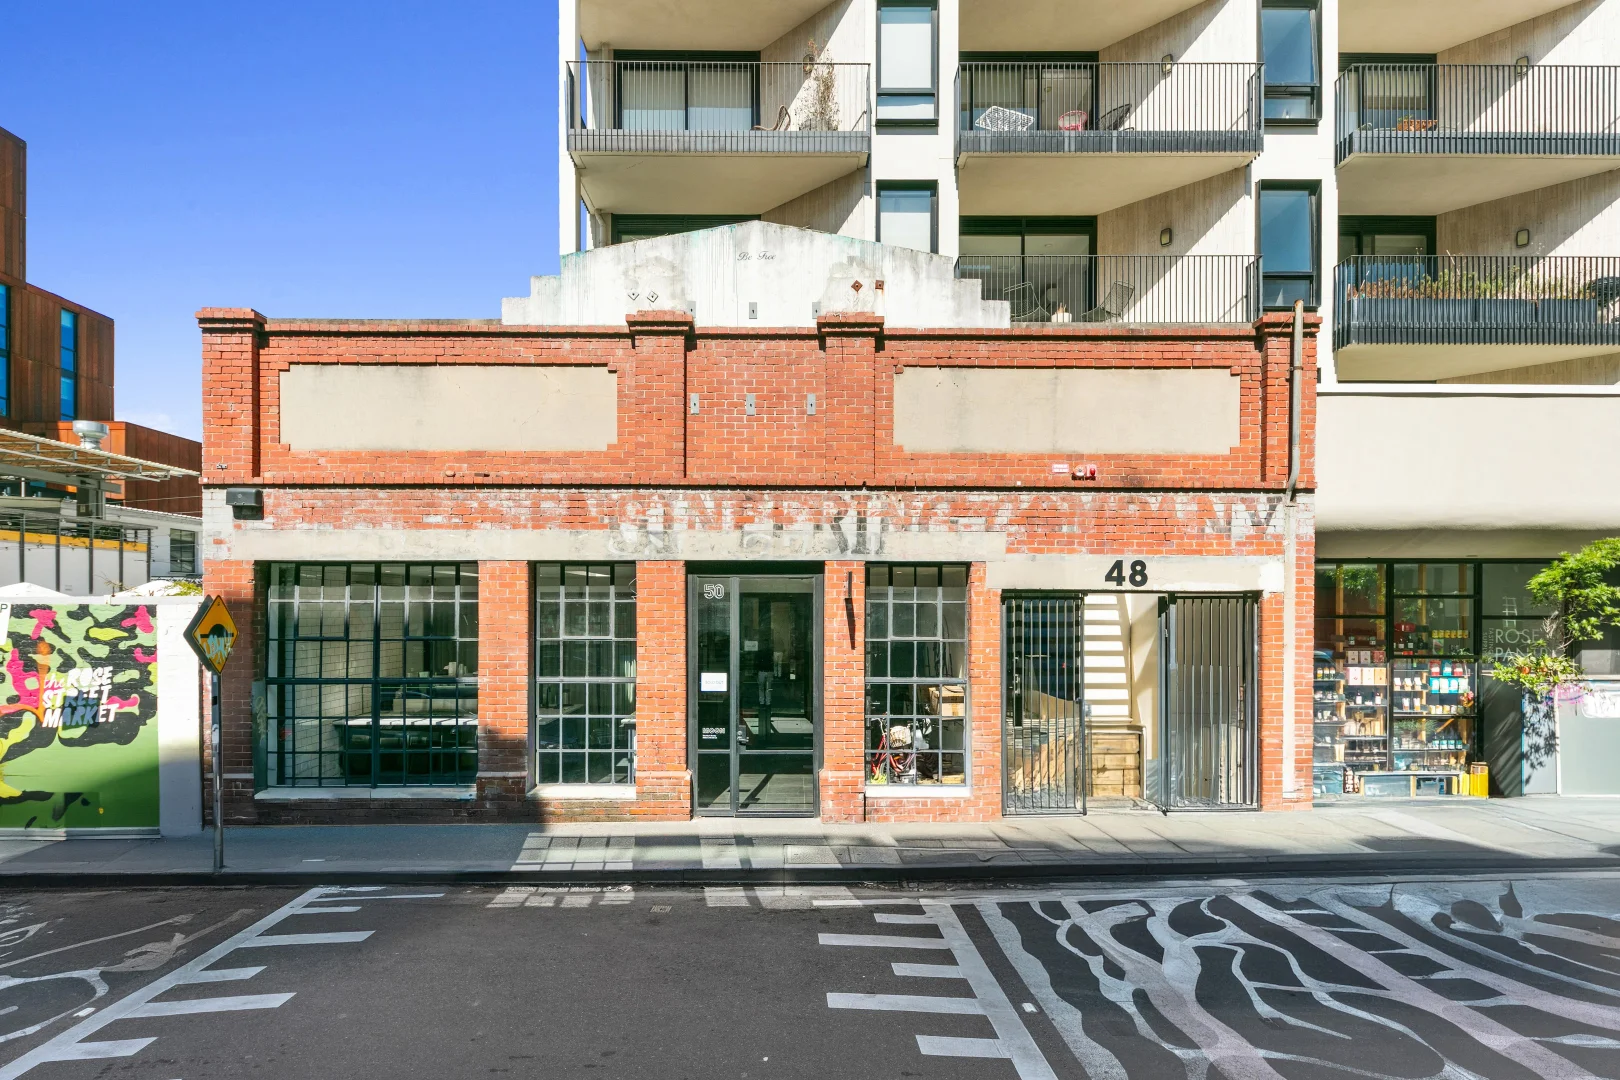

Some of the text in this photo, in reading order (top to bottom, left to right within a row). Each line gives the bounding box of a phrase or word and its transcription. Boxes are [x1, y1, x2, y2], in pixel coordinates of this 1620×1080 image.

[737, 250, 776, 261] Be Free
[1104, 559, 1149, 587] 48
[703, 583, 725, 600] 50
[1495, 629, 1540, 643] ROSE
[43, 666, 113, 689] the ROSE
[42, 685, 113, 709] STREET
[42, 703, 119, 728] MARKET
